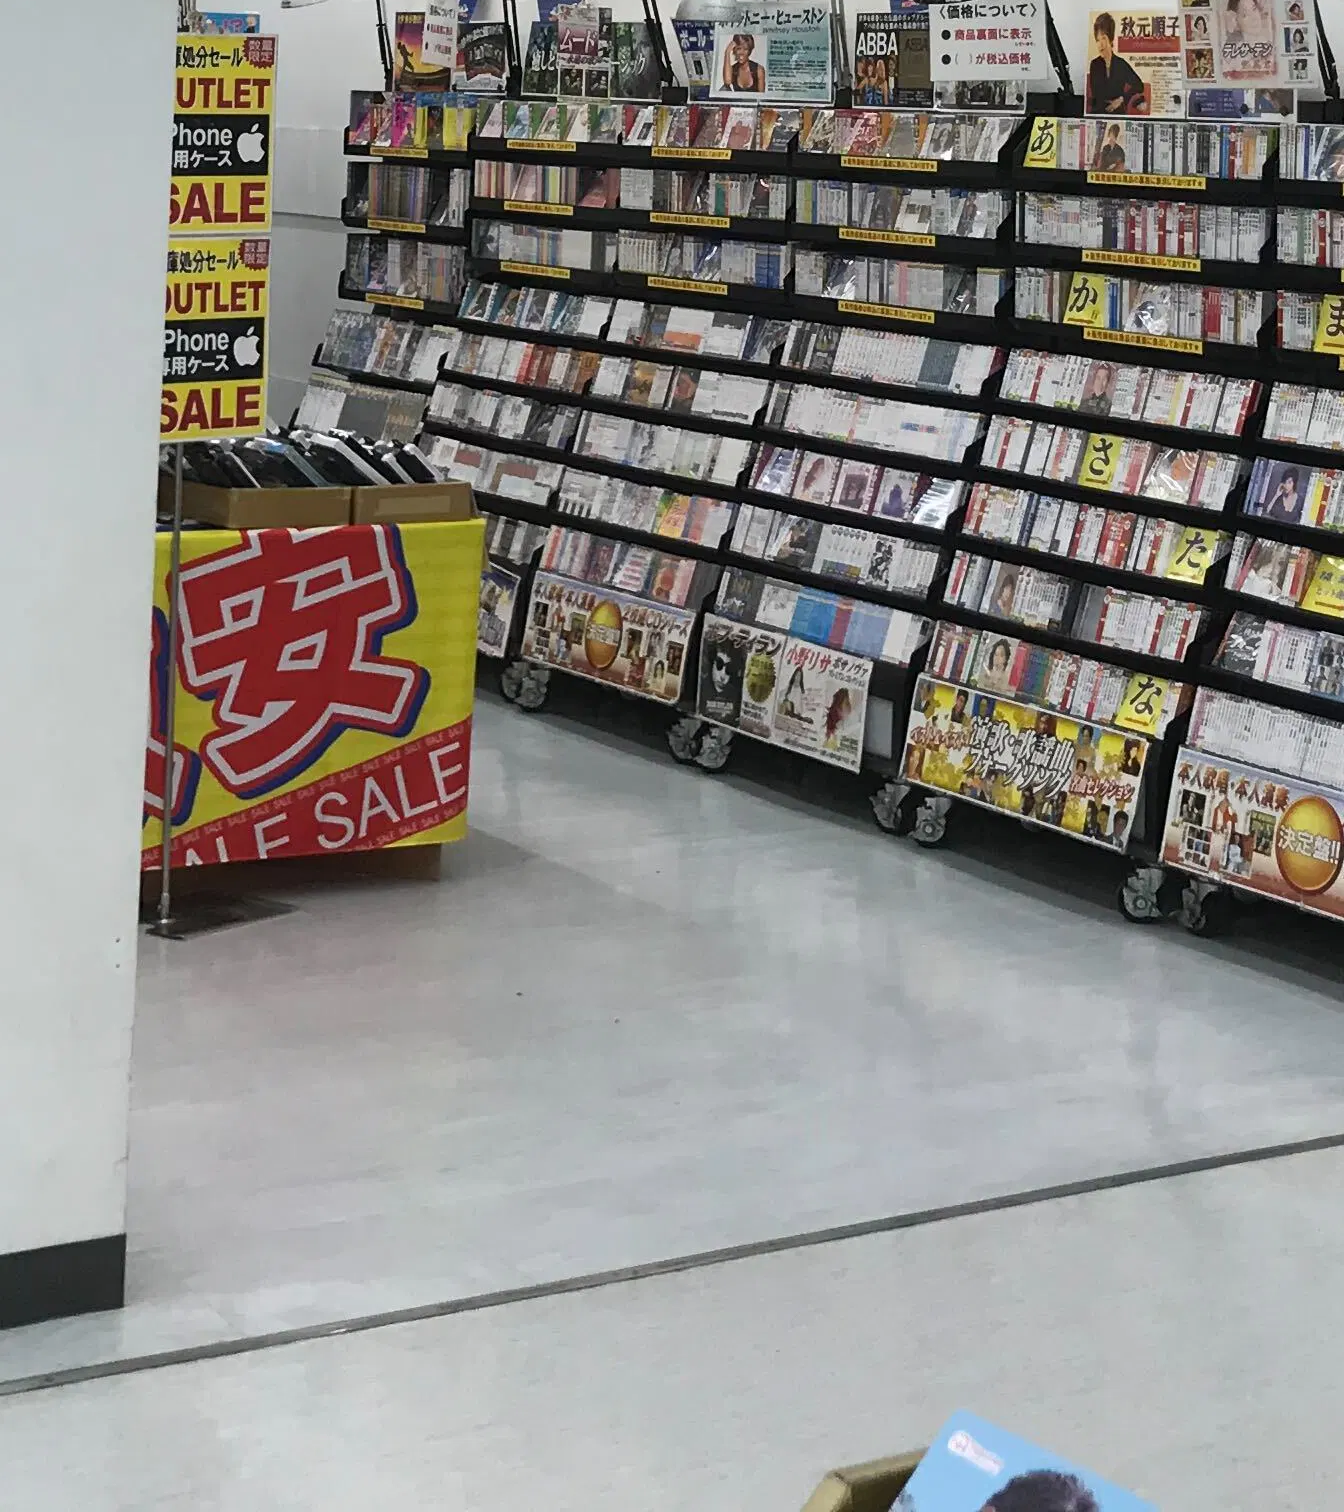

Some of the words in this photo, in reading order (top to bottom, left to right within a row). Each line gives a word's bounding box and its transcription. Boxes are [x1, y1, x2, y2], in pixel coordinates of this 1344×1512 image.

[559, 27, 598, 54] ムード
[856, 32, 899, 56] ABBA
[1120, 16, 1180, 39] 秋元順子
[1222, 42, 1273, 59] テレサ・テン
[1031, 119, 1055, 156] あ
[166, 281, 266, 315] UTLET
[1068, 276, 1099, 313] か
[161, 384, 261, 433] SALE
[1089, 438, 1114, 476] さ
[1175, 531, 1208, 568] た
[1129, 676, 1162, 716] な
[315, 742, 467, 849] SALE
